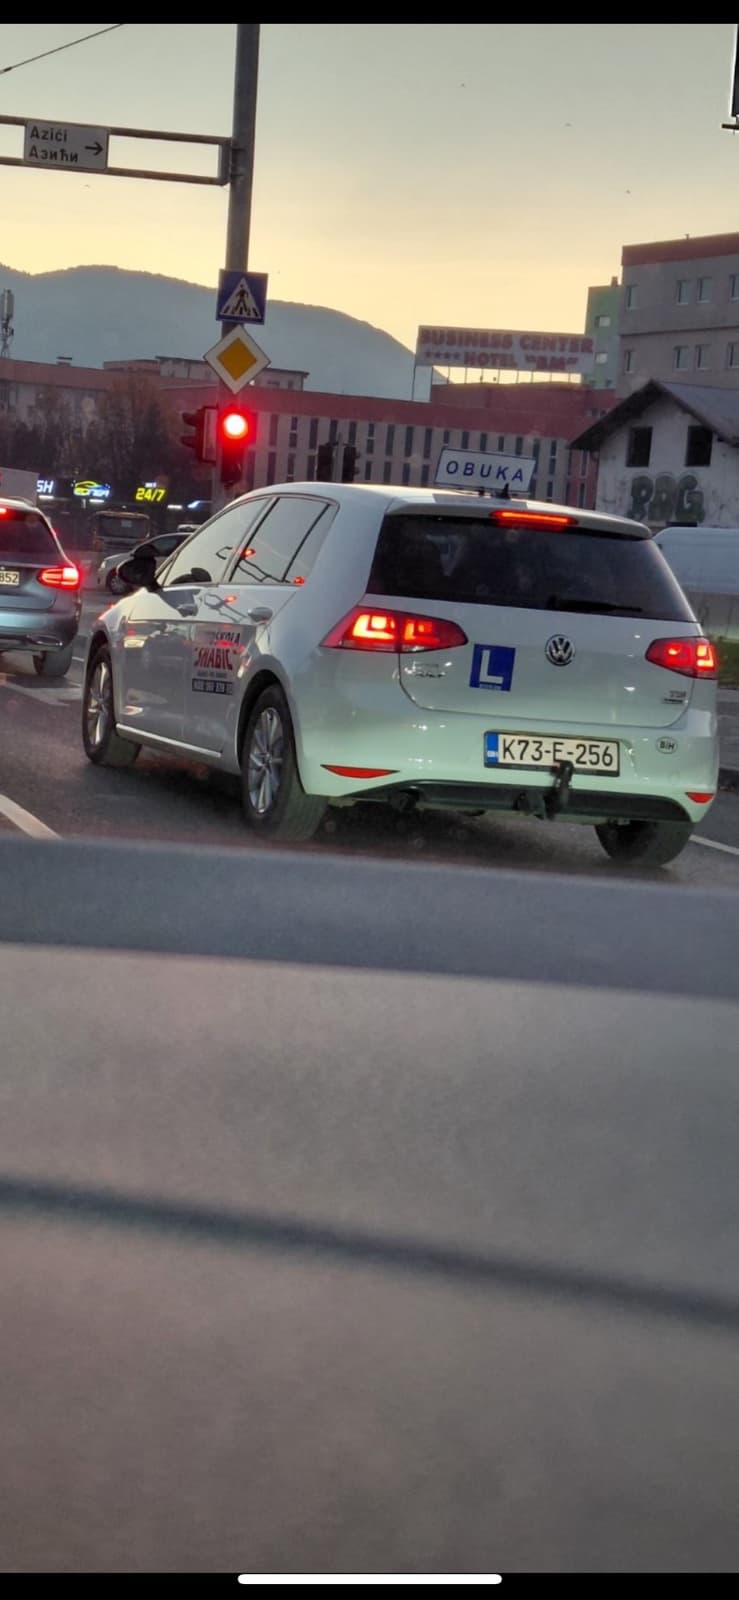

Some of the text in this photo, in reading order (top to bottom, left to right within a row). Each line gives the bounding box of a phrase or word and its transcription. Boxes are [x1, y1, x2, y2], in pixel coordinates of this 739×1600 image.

[30, 125, 67, 142] Azići
[29, 145, 78, 162] Азићи
[419, 328, 594, 353] BUSINESS CENTER
[463, 351, 517, 368] HOTEL
[446, 460, 523, 482] OBUKA
[135, 488, 166, 502] 24/7
[479, 649, 504, 684] L
[502, 738, 614, 768] K73-E-256
